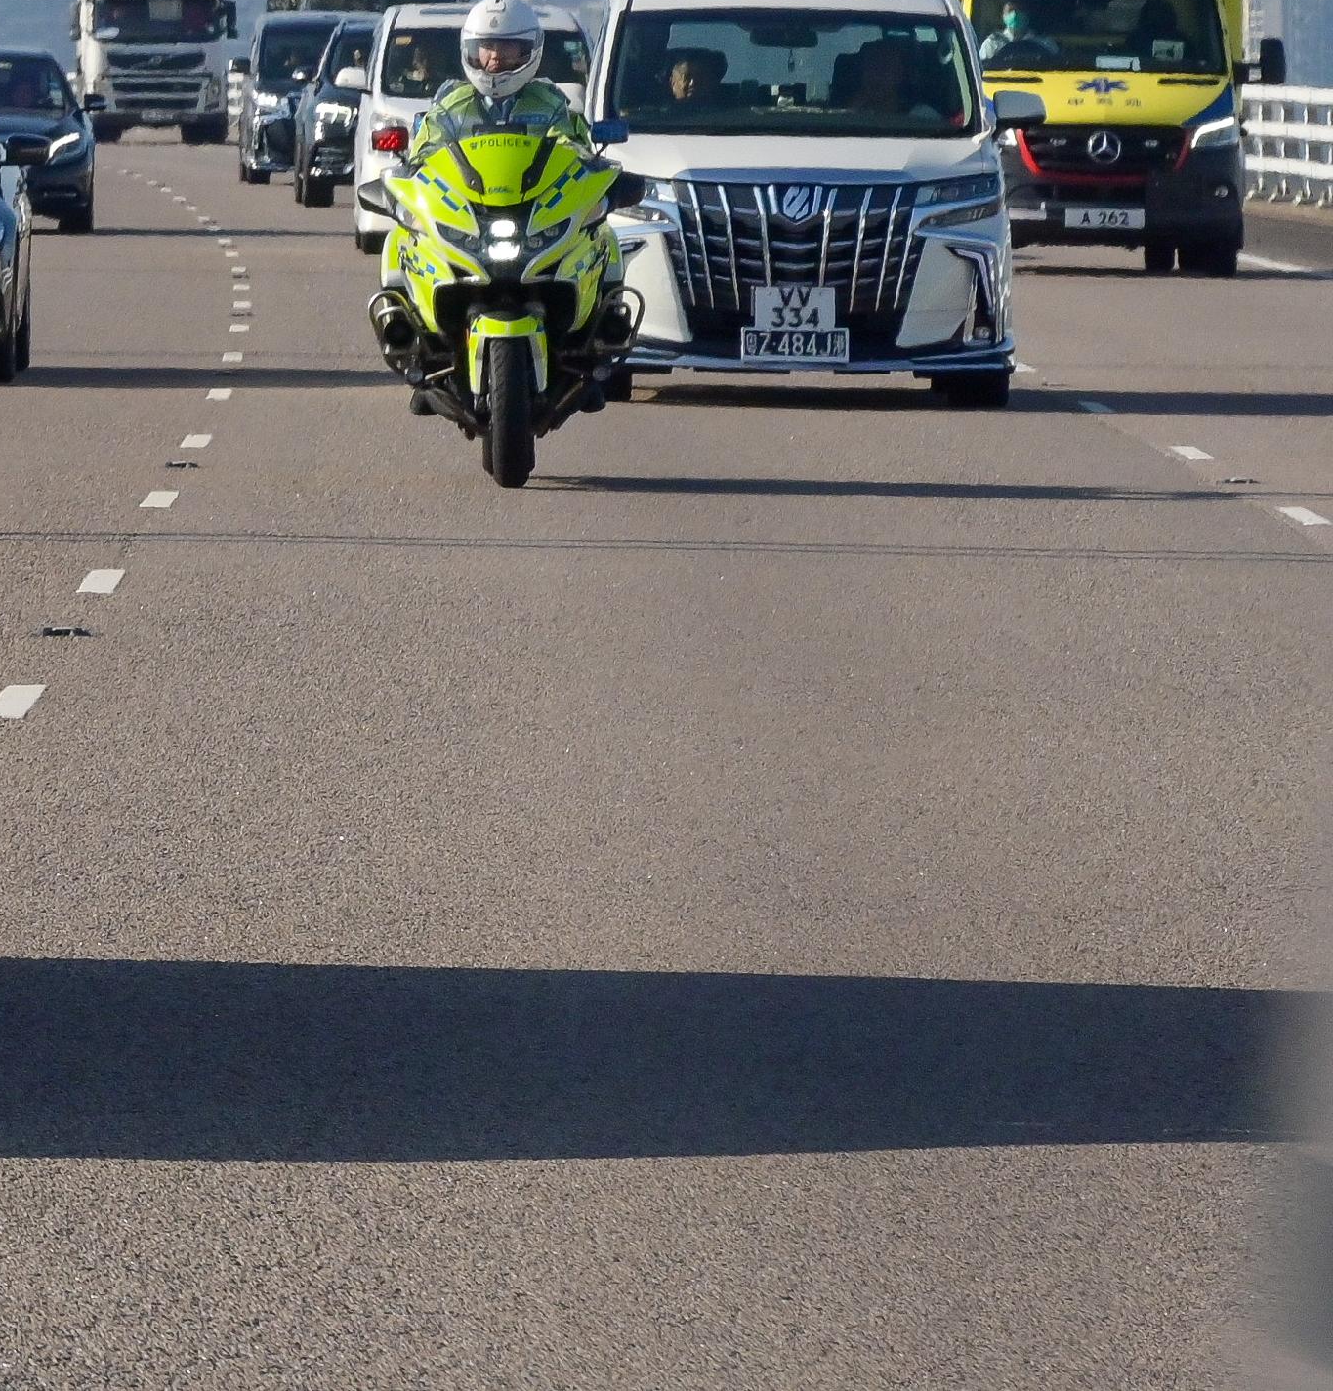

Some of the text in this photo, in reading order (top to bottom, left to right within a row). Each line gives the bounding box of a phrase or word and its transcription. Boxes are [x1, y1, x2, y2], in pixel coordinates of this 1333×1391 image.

[1081, 211, 1091, 225] A
[778, 287, 812, 307] VV
[770, 307, 820, 328] 334
